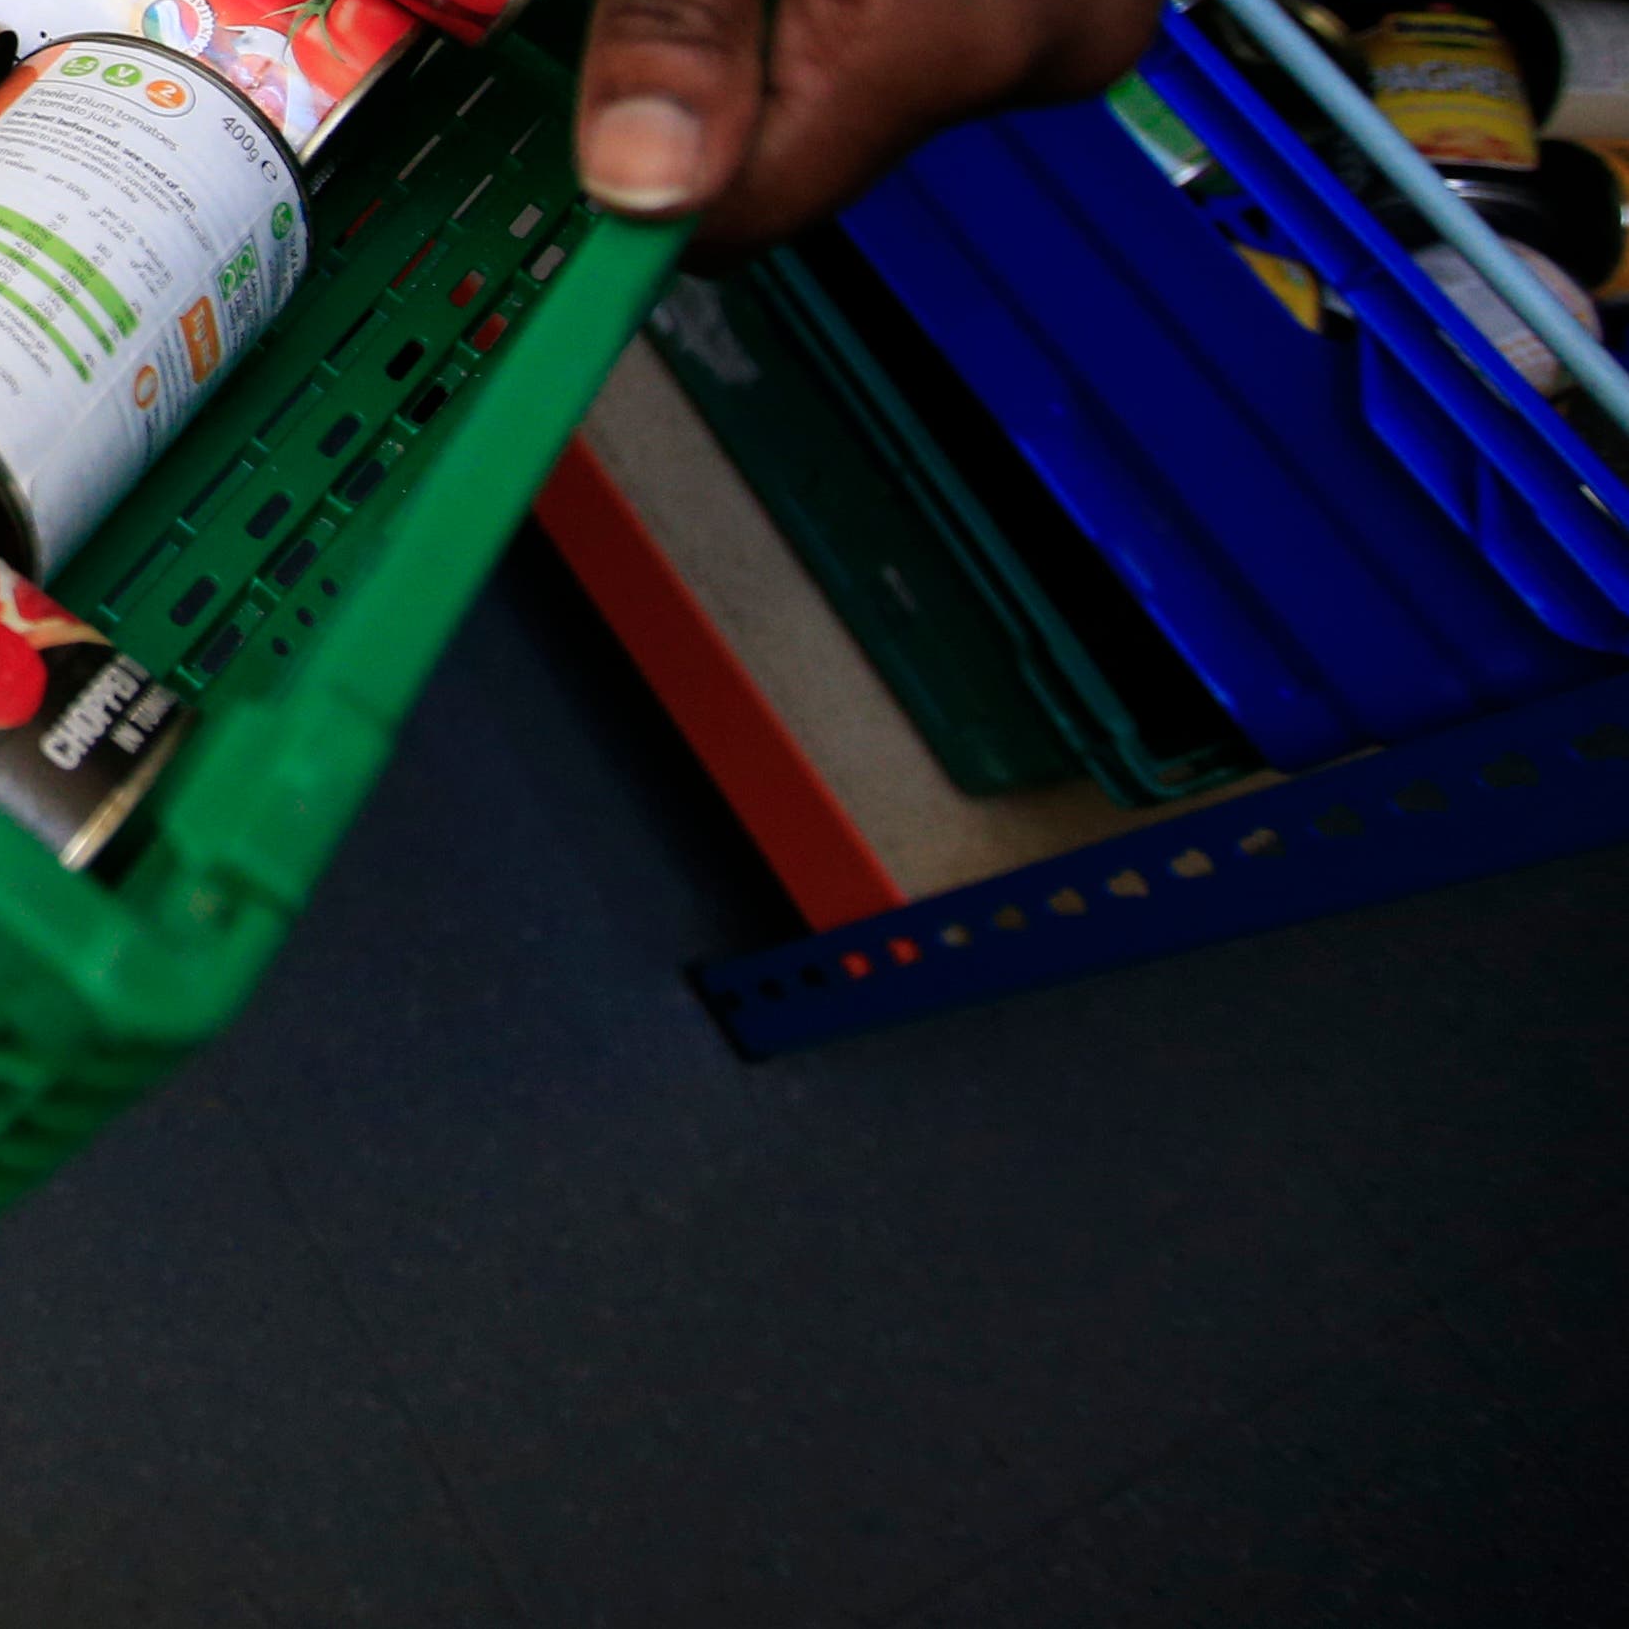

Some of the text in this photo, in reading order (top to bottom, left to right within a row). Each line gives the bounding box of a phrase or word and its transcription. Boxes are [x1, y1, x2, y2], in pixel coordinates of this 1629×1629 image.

[78, 93, 116, 114] plum
[115, 108, 180, 152] tomatoes
[221, 114, 262, 165] 400g
[142, 160, 167, 181] end
